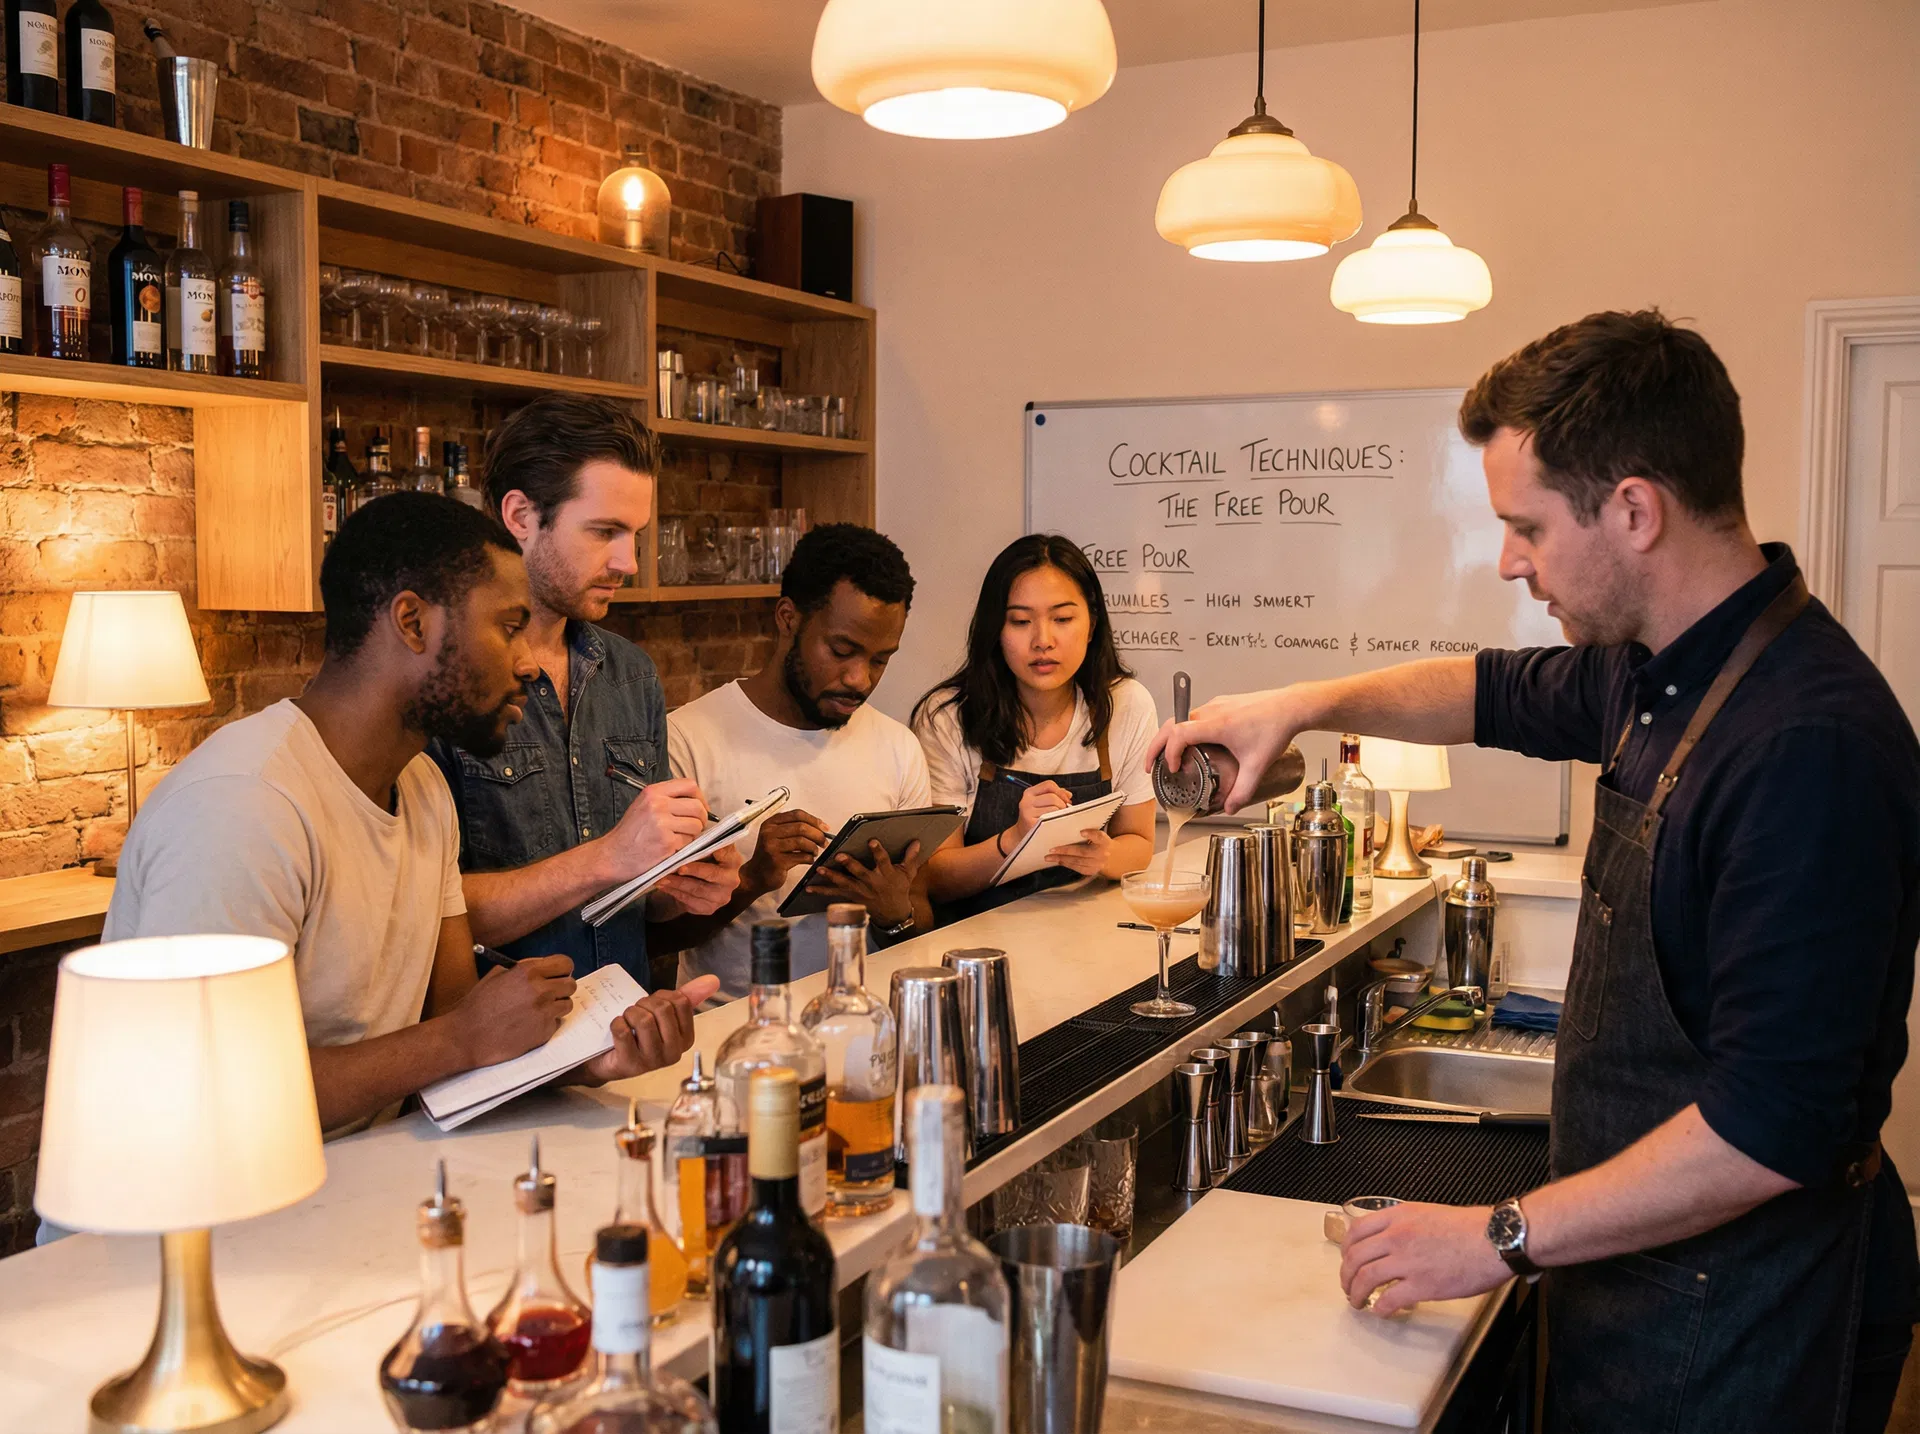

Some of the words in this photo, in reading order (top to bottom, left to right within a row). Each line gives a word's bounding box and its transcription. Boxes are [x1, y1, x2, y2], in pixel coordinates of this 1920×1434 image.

[1108, 442, 1226, 478] COCKTAIL
[1240, 437, 1404, 472] TECHNIQUES:
[1158, 492, 1199, 518] THE
[1215, 490, 1263, 517] FREE
[1279, 488, 1335, 516] POUR
[1081, 543, 1128, 568] FREE
[1142, 543, 1190, 568] POUR
[1206, 593, 1241, 608] HIGH
